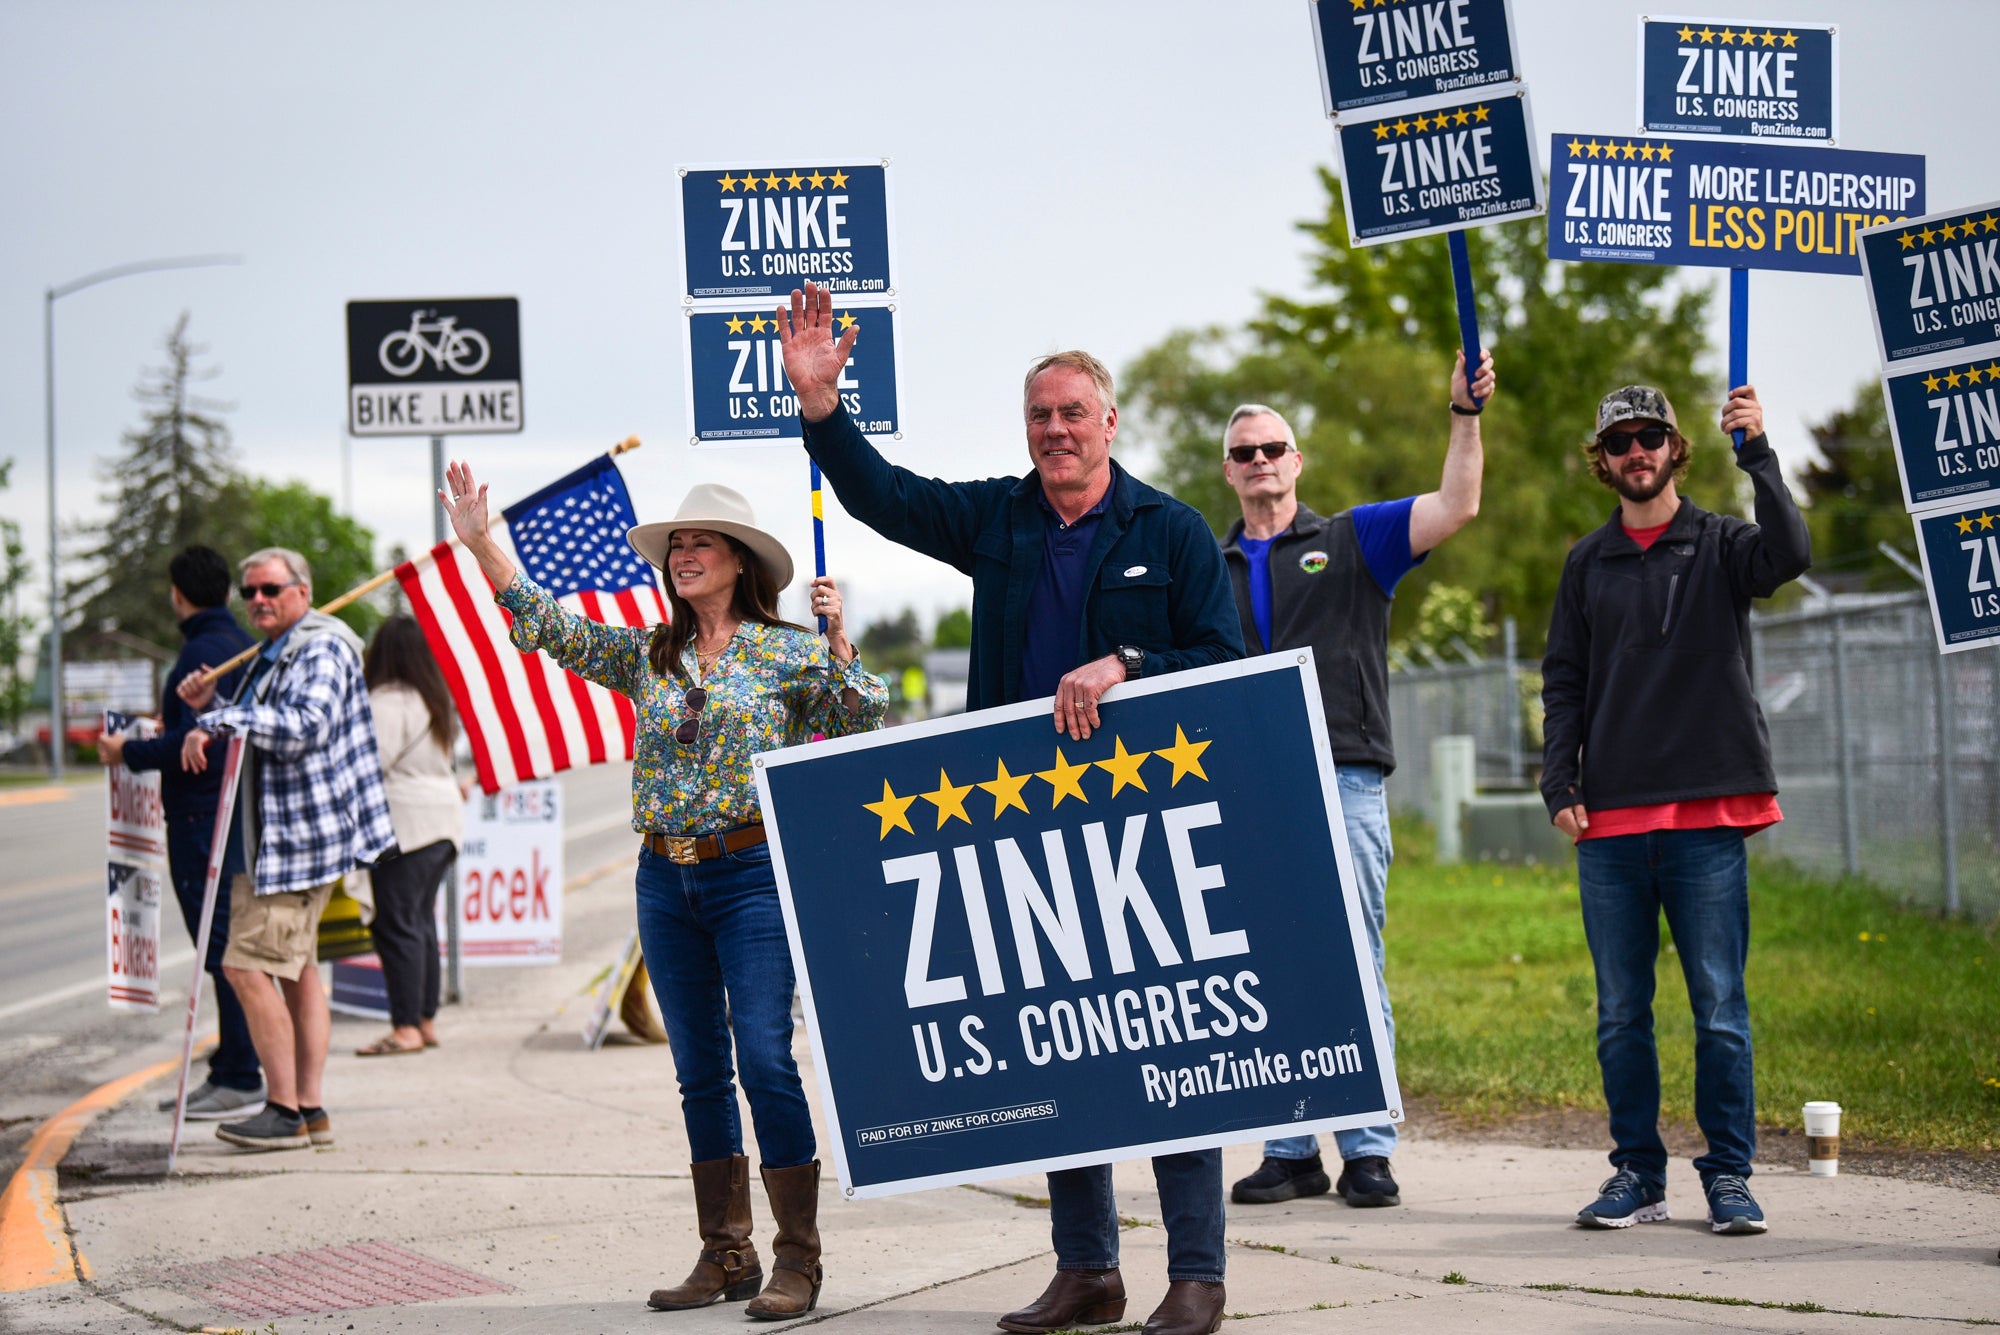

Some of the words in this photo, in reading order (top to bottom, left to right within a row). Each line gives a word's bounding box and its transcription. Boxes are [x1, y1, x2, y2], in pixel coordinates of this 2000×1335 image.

[1353, 0, 1475, 64] ZINKE
[1359, 65, 1392, 88] U.S.
[1396, 48, 1480, 81] CONGRESS
[1435, 69, 1509, 92] RyanZinke.com
[1676, 47, 1798, 98] ZINKE
[1676, 97, 1707, 116] U.S.
[1713, 98, 1798, 121] CONGRESS
[1751, 122, 1826, 137] RyanZinke.com
[1376, 126, 1498, 193] ZINKE
[1383, 193, 1415, 216] U.S.
[1419, 177, 1502, 210] CONGRESS
[1565, 163, 1672, 222] ZINKE
[1689, 164, 1759, 202] MORE
[1766, 168, 1916, 211] LEADERSHIP
[720, 195, 851, 251] ZINKE
[1458, 198, 1531, 221] RyanZinke.com
[1565, 221, 1592, 244] U.S.
[1597, 222, 1672, 248] CONGRESS
[1689, 204, 1766, 250] LESS
[1775, 209, 1911, 255] POLIT
[721, 254, 756, 277] U.S.
[762, 251, 853, 275] CONGRESS
[804, 277, 884, 292] anZinke.com
[1912, 310, 1947, 335] U.S.
[728, 337, 859, 393] ZINE
[357, 392, 422, 425] BIKE
[442, 390, 514, 424] LANE
[729, 396, 764, 419] U.S.
[770, 393, 861, 417] CONSS
[1937, 452, 1972, 477] U.S.
[1976, 445, 2000, 469] CO
[464, 847, 550, 922] acek
[882, 801, 1250, 1008] ZINKE
[911, 1014, 1007, 1083] U.S.
[1019, 970, 1268, 1067] CONGRESS
[1140, 1042, 1363, 1109] RyanZinke.com
[861, 1129, 887, 1143] PAID
[888, 1126, 912, 1139] FOR
[914, 1123, 929, 1135] BY
[931, 1118, 965, 1132] ZINKE
[966, 1114, 990, 1127] FOR
[991, 1104, 1054, 1123] CONGRESS
